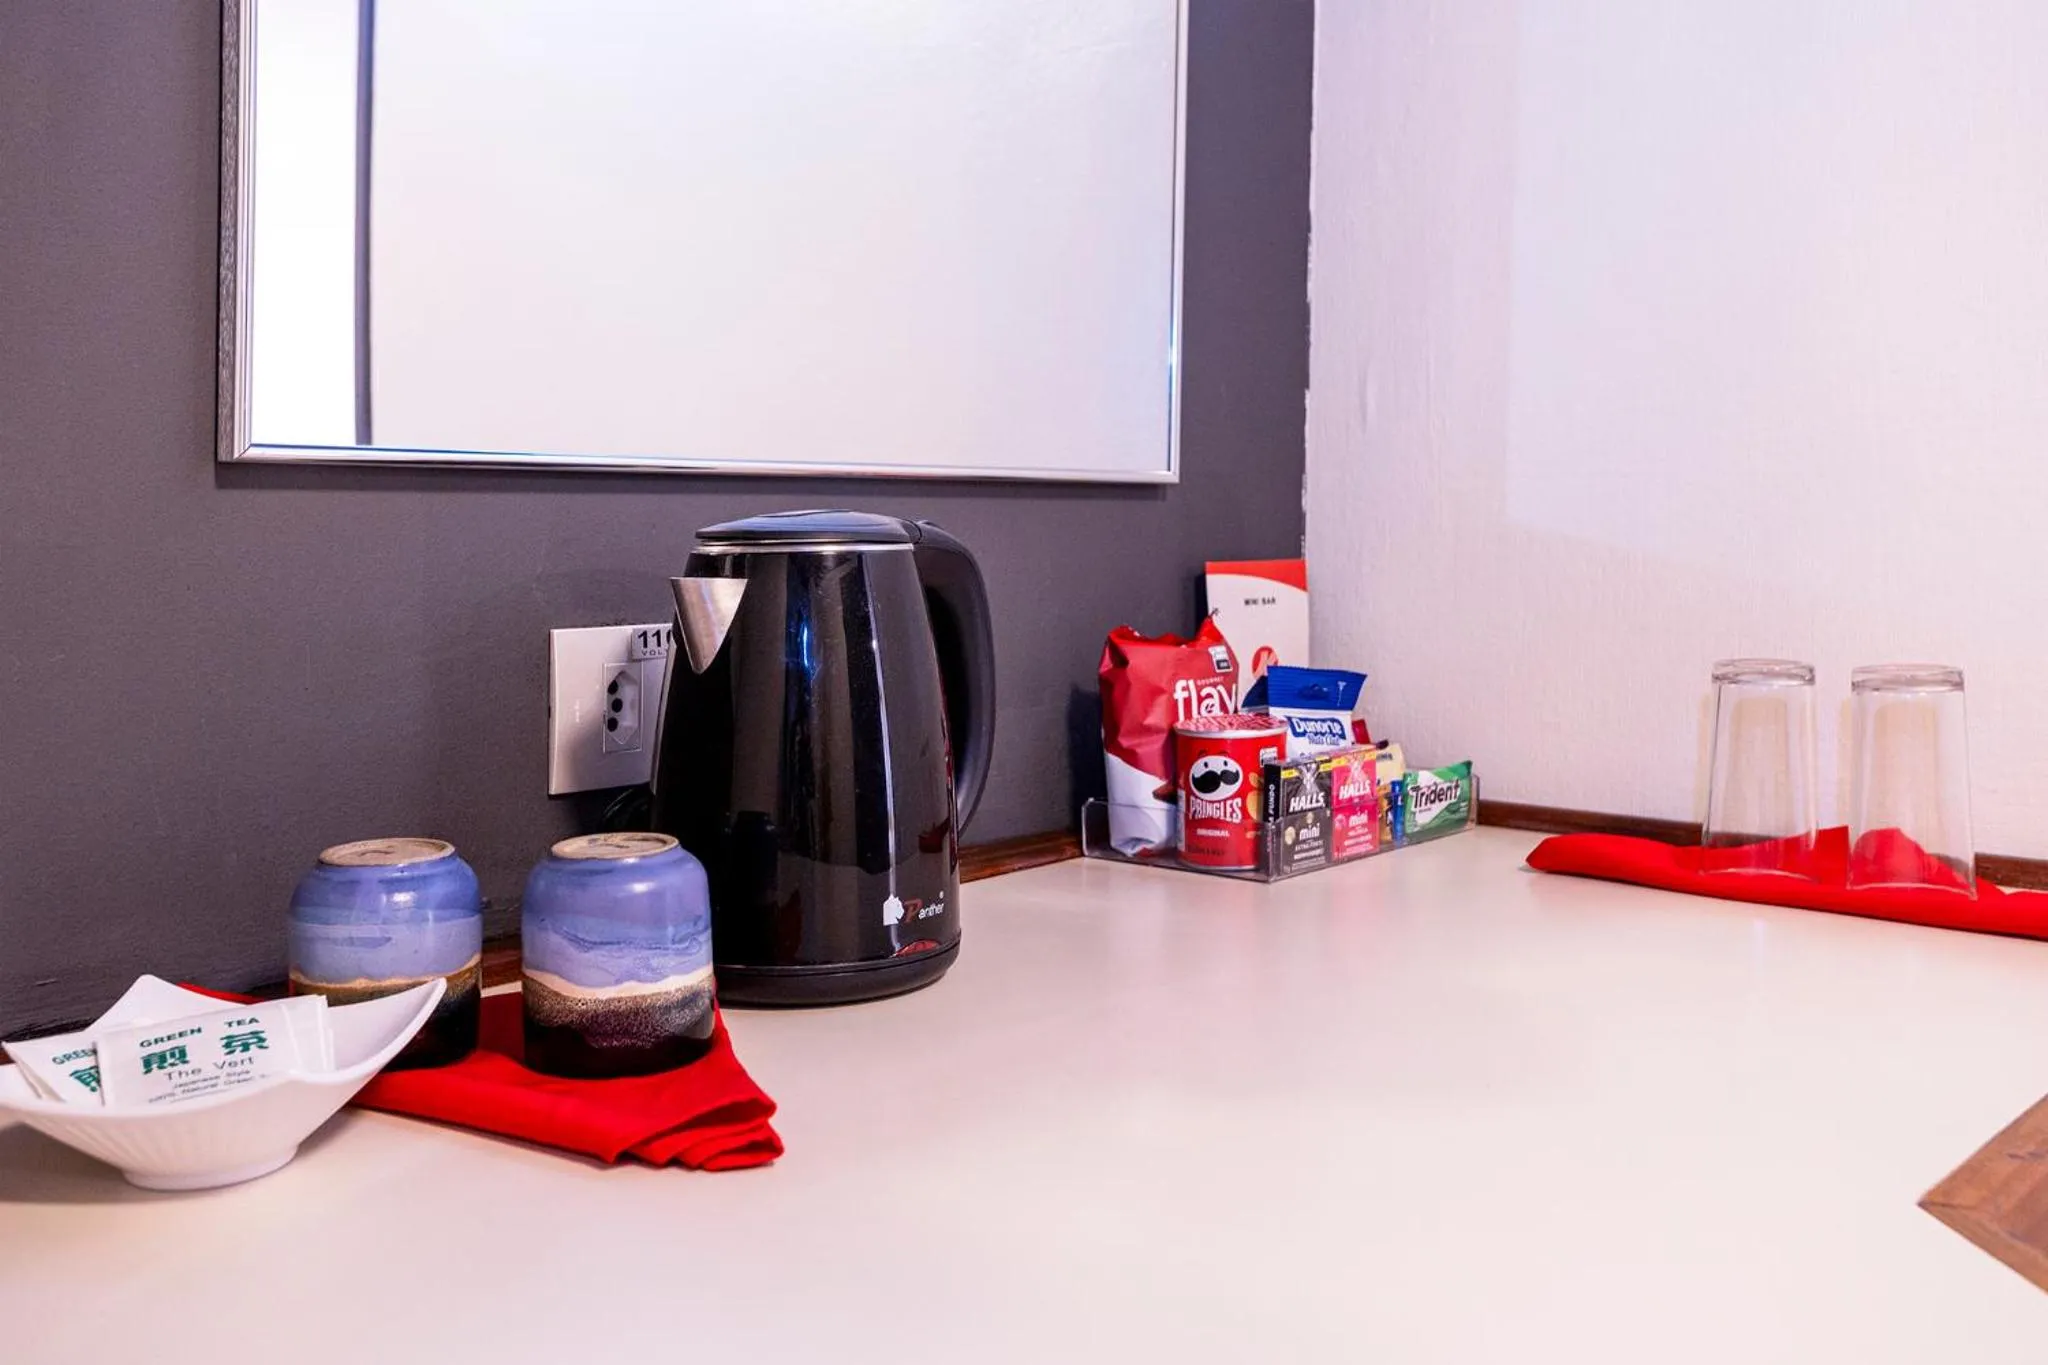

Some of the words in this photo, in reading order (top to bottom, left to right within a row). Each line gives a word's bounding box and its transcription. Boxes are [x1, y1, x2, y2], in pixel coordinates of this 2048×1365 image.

[641, 648, 666, 656] VOL
[1339, 780, 1371, 800] HALLS
[1410, 779, 1461, 809] Trident
[1189, 796, 1243, 824] PRINGLES
[1289, 792, 1325, 813] HALLS
[1349, 810, 1368, 827] mini
[1196, 828, 1230, 837] ORIGINAL
[1299, 823, 1320, 840] mini
[139, 1027, 202, 1048] GREEN
[223, 1017, 260, 1028] TEA
[219, 1030, 269, 1055] 茶
[164, 1067, 202, 1081] The
[213, 1056, 255, 1070] Vert
